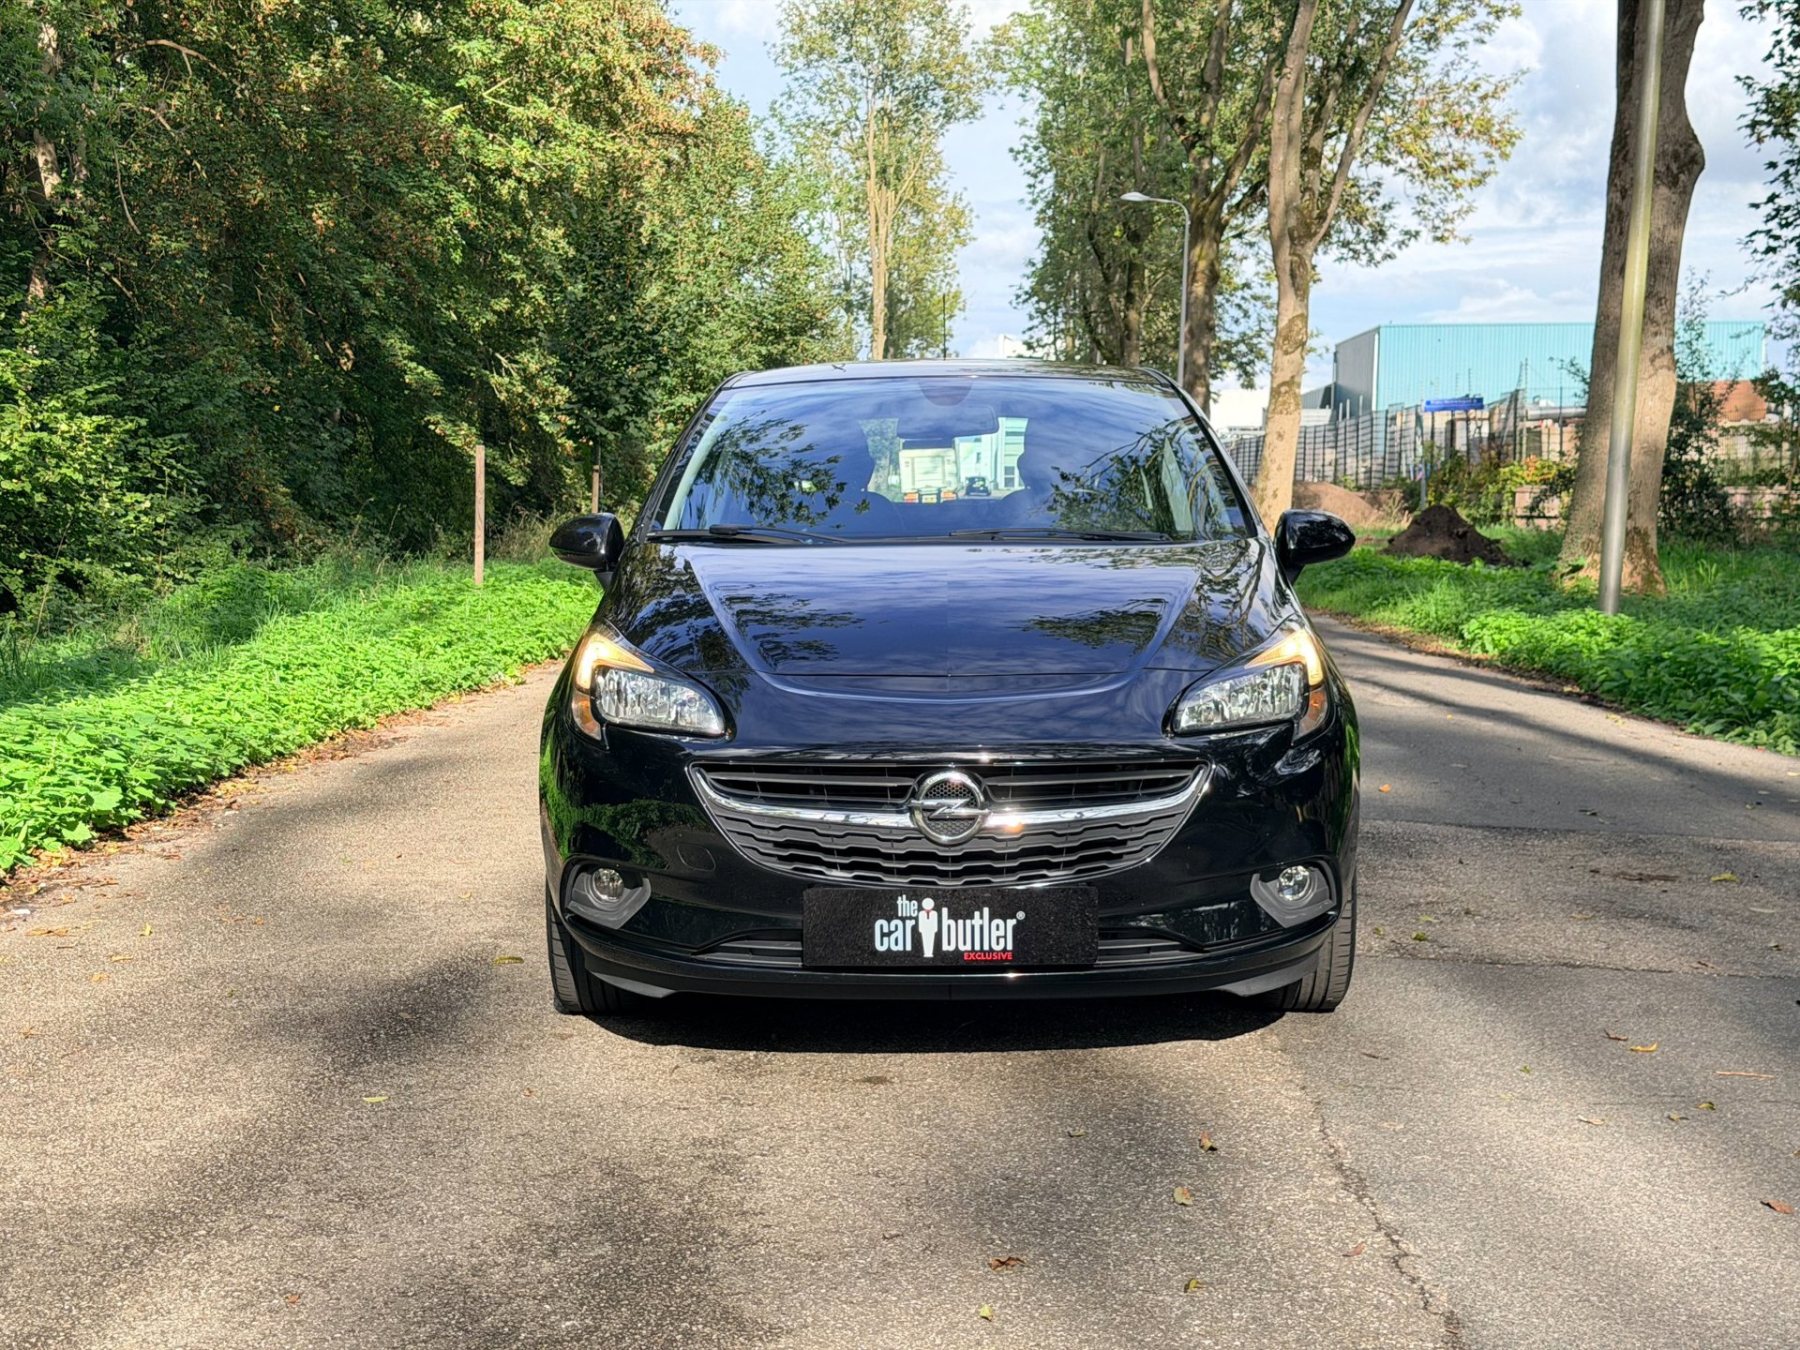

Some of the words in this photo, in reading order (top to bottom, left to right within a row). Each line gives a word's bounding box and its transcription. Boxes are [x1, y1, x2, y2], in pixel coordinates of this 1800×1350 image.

[896, 894, 918, 917] the
[874, 918, 915, 951] car
[963, 951, 1013, 961] EXCLUSIVE
